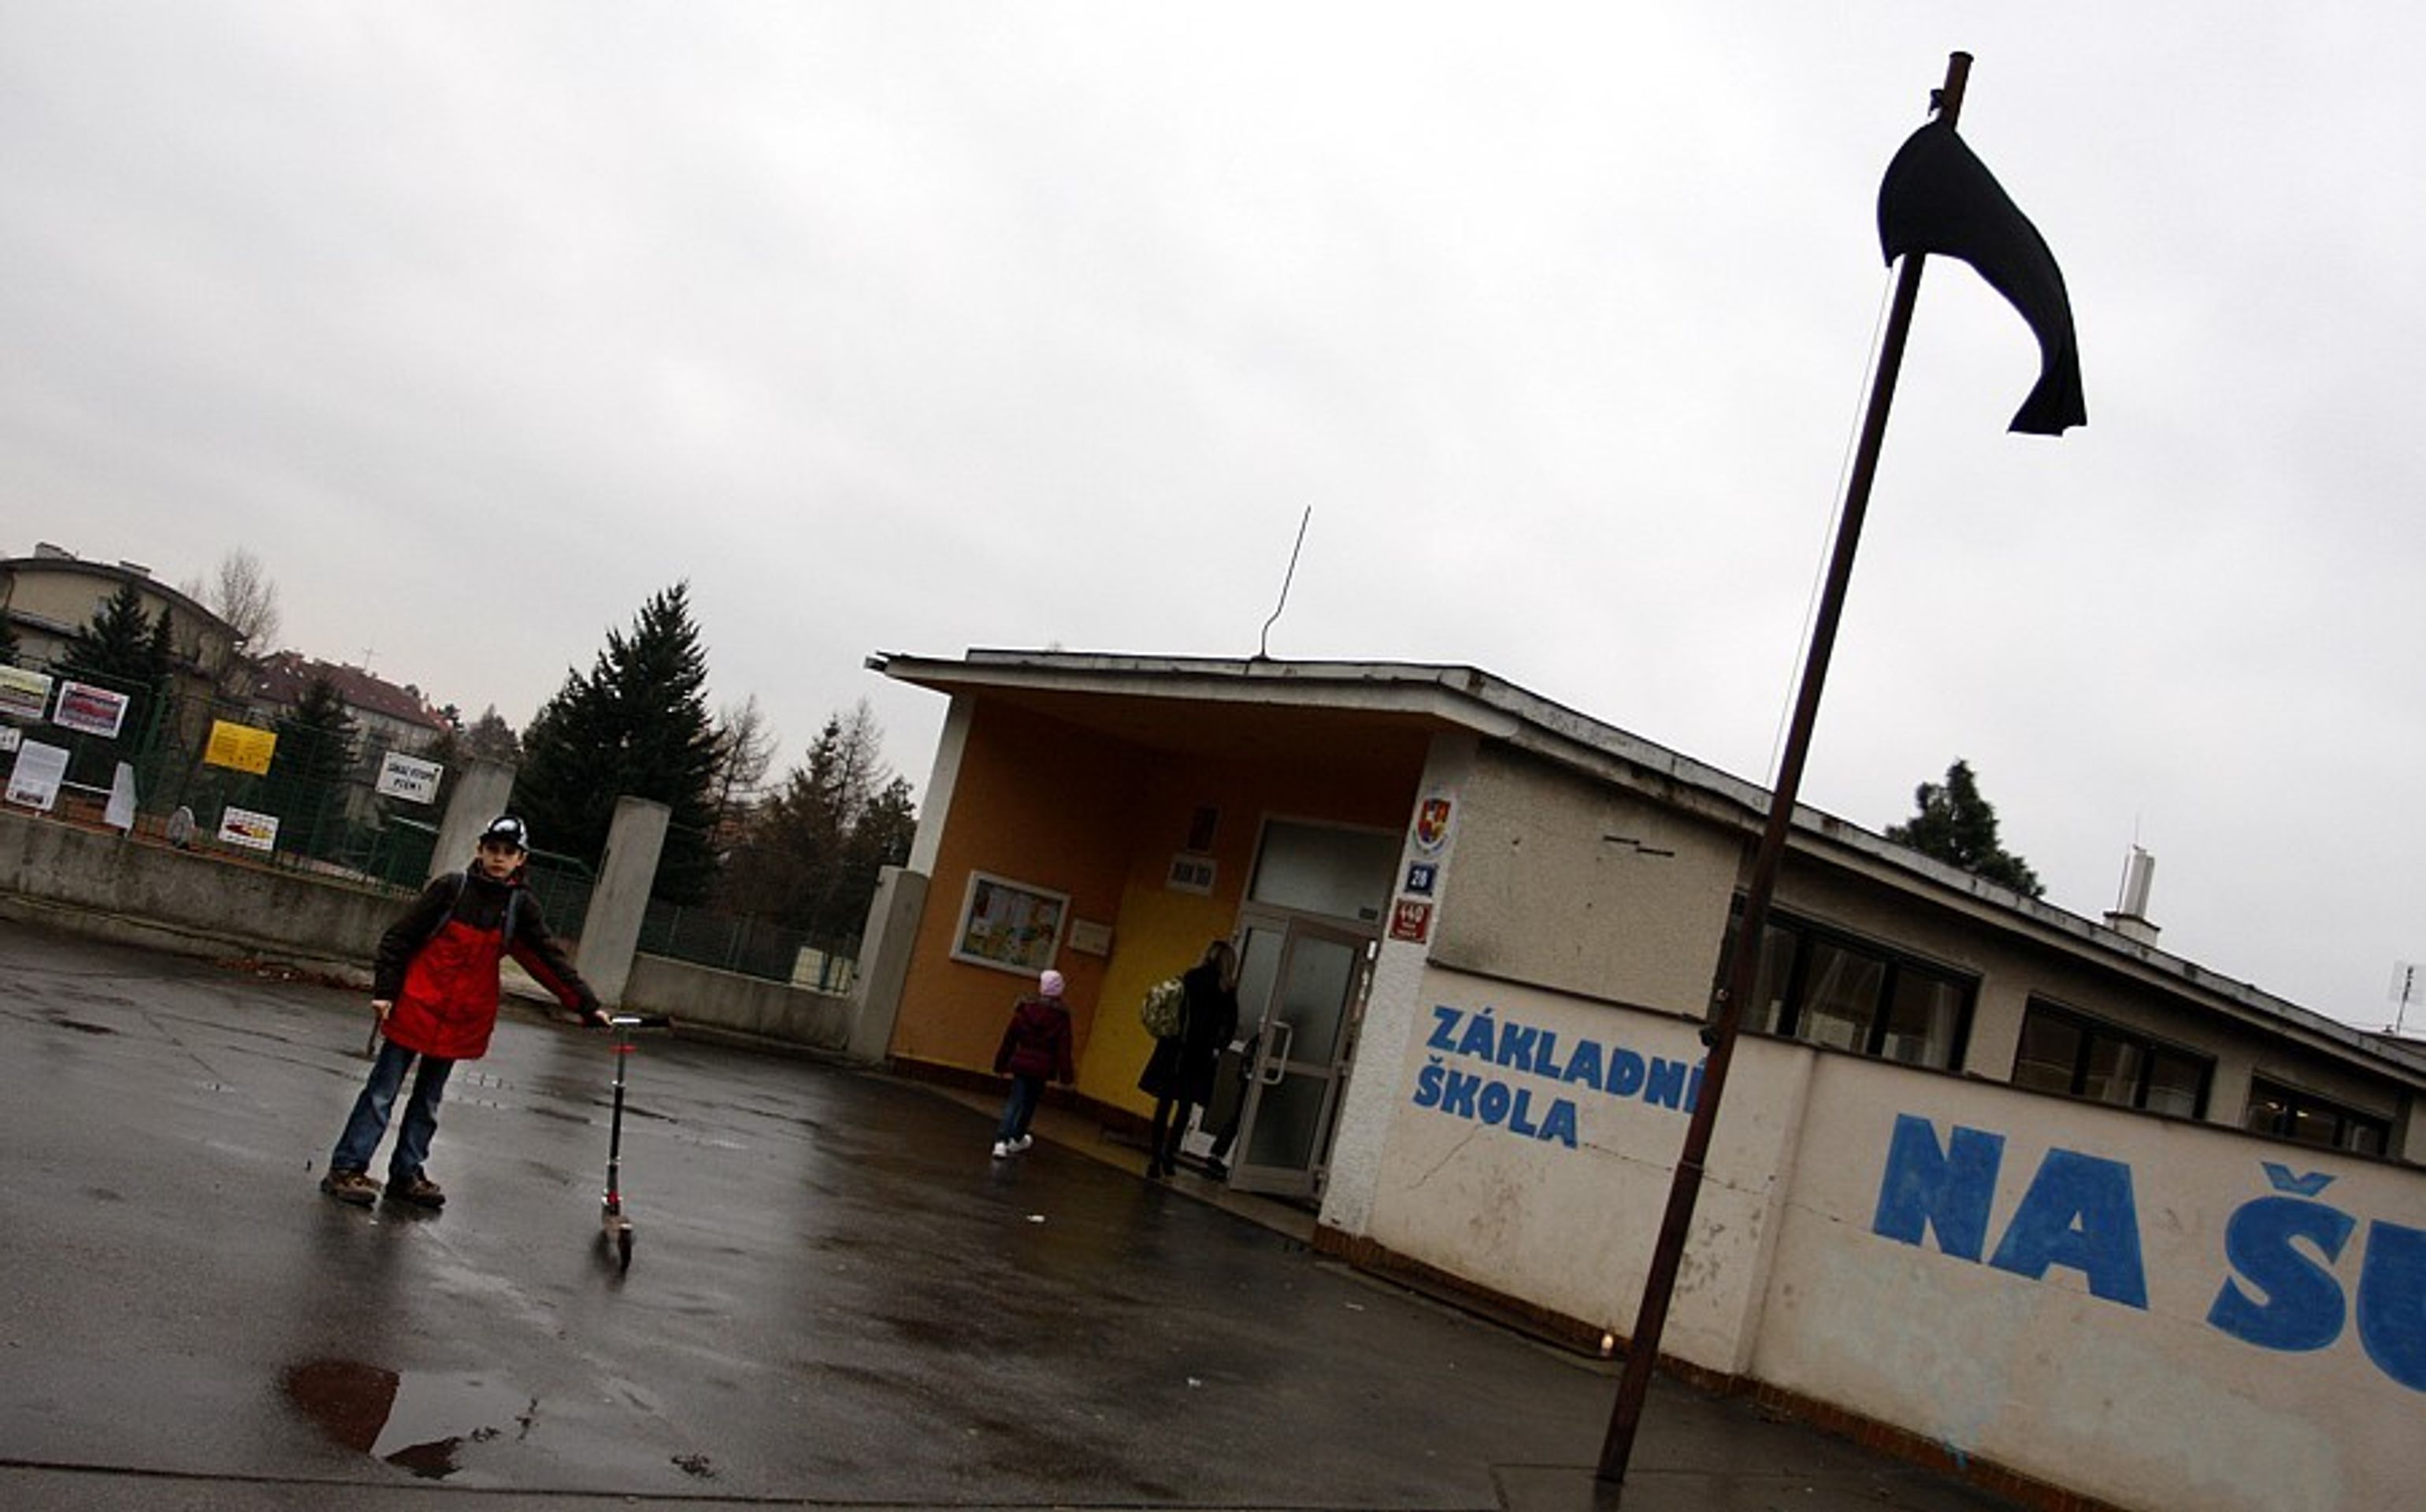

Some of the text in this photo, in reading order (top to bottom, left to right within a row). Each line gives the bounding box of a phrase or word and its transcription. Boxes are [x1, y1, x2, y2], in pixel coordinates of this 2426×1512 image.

[1412, 1054, 1578, 1149] ŠKOLA
[1426, 1005, 1708, 1114] ZÁKLADNÍ
[1871, 1112, 2149, 1311] NA
